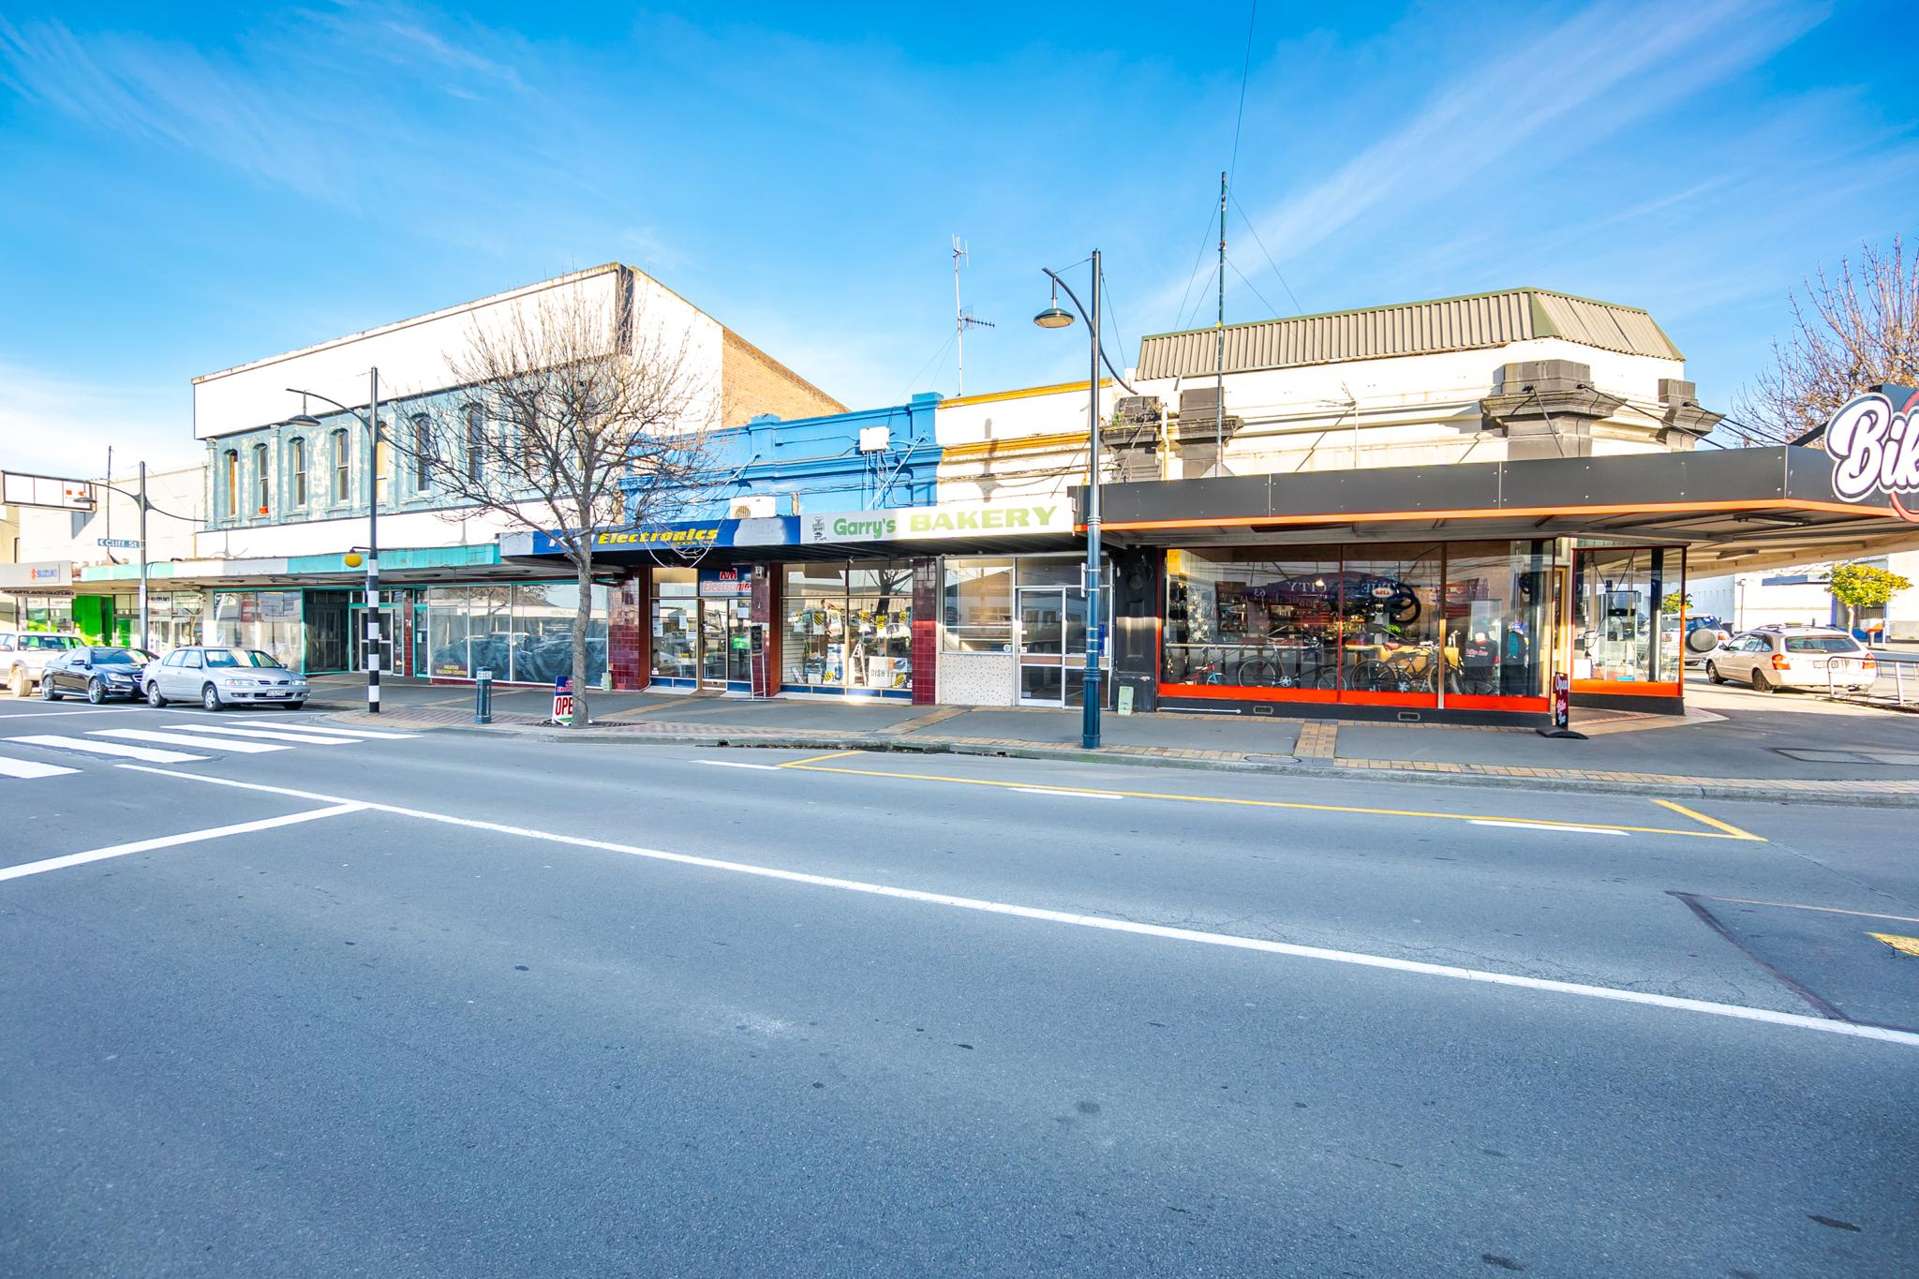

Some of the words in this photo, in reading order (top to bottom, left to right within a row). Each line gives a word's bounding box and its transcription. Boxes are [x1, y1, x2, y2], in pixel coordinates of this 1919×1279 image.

[833, 517, 897, 539] Garry's
[909, 505, 1057, 532] BAKERY
[597, 528, 717, 545] Electronics
